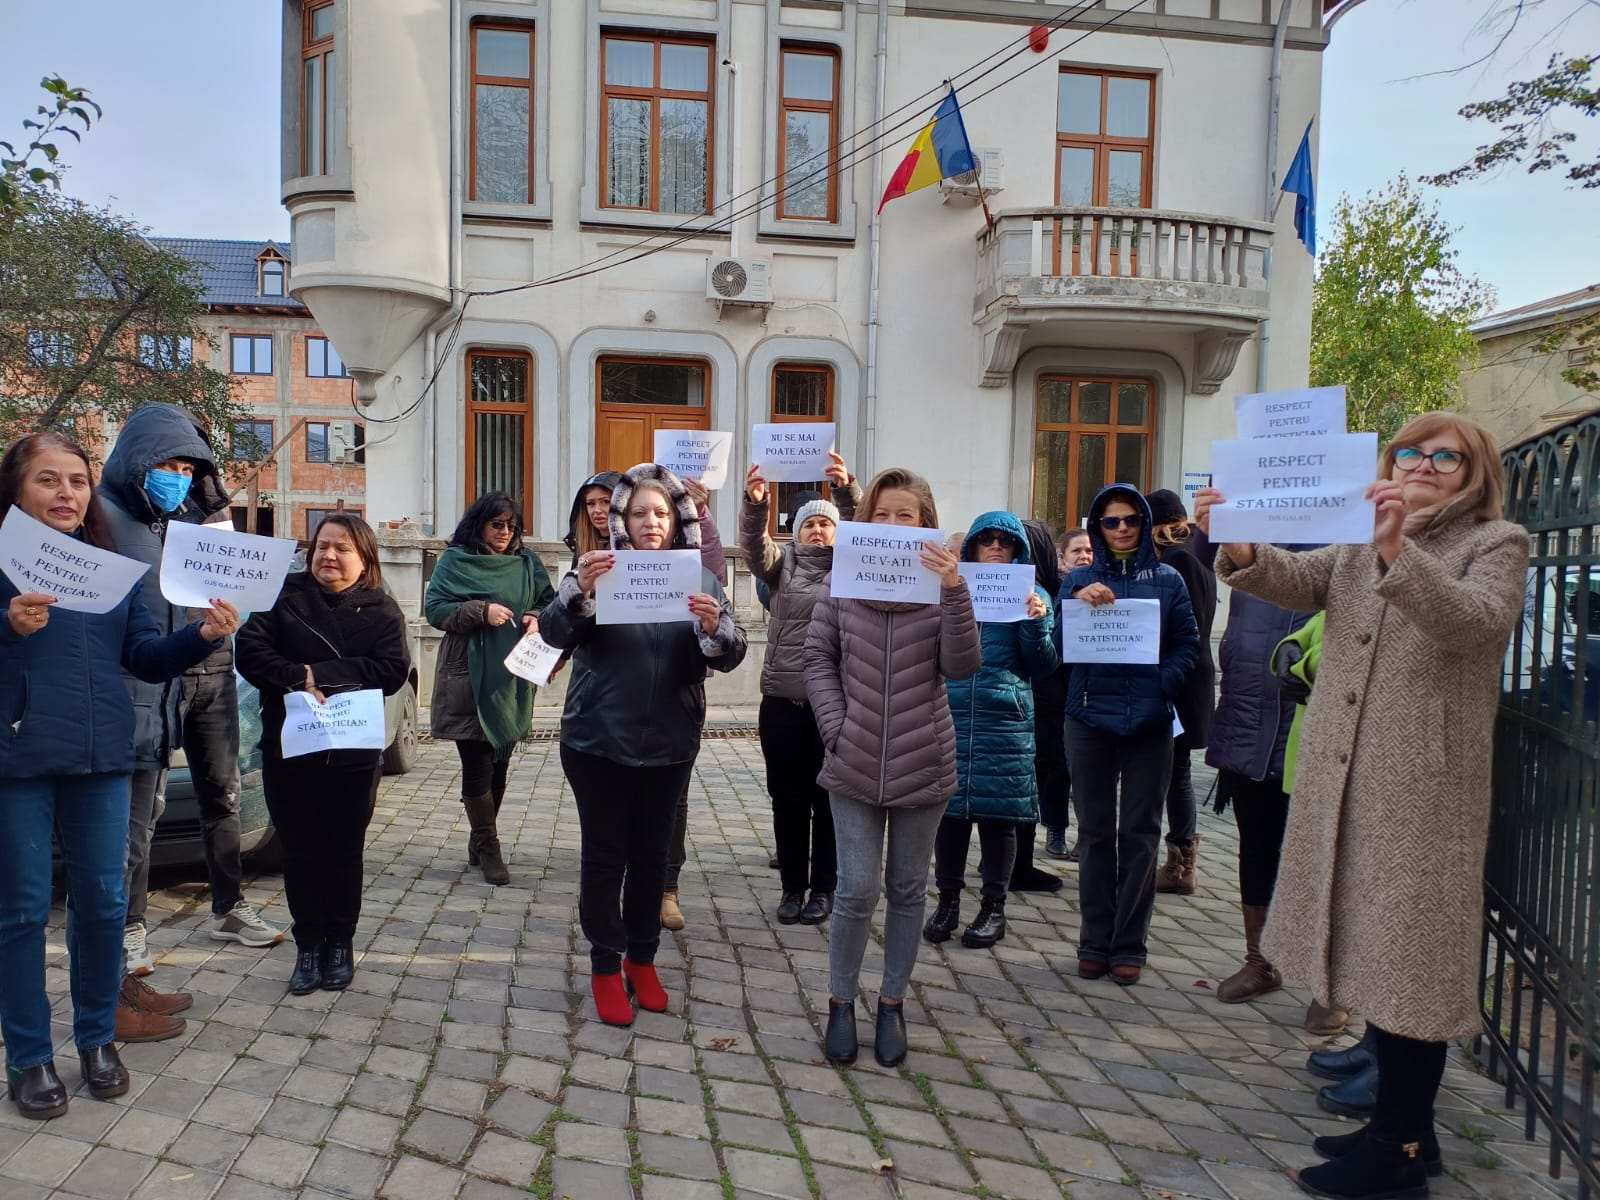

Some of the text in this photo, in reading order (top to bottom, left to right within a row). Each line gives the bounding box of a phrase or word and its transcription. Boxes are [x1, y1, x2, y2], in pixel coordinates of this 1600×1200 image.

[1265, 401, 1312, 414] RESPECT
[1269, 416, 1310, 427] PENTRU
[771, 433, 816, 441] NU SE MAI
[676, 440, 712, 448] RESPECT
[678, 452, 709, 460] PENTRU
[765, 447, 821, 456] POATE ASA!
[1258, 454, 1327, 468] RESPECT
[1263, 476, 1321, 489] PENTRU
[1236, 496, 1346, 509] STATISTICIAN!
[852, 535, 924, 551] RESPECTATI
[40, 542, 103, 572] RESPECT
[196, 541, 267, 562] NU SE MAI
[861, 554, 911, 567] CE V-ATI
[35, 558, 89, 584] PENTRU
[184, 558, 269, 580] POATE ASA!
[627, 563, 671, 572] RESPECT
[10, 558, 100, 600] STATISTICIAN!
[630, 577, 669, 586] PENTRU
[855, 571, 916, 585] ASUMAT!!!
[975, 573, 1011, 581] RESPECT
[977, 584, 1008, 592] PENTRU
[613, 591, 684, 601] STATISTICIAN!
[971, 595, 1020, 604] ATISTICIAN!
[1090, 609, 1131, 617] RESPECT
[1093, 622, 1129, 630] PENTRU
[1078, 634, 1144, 643] STATISTICIAN!
[297, 720, 368, 733] STATISTICIAN!
